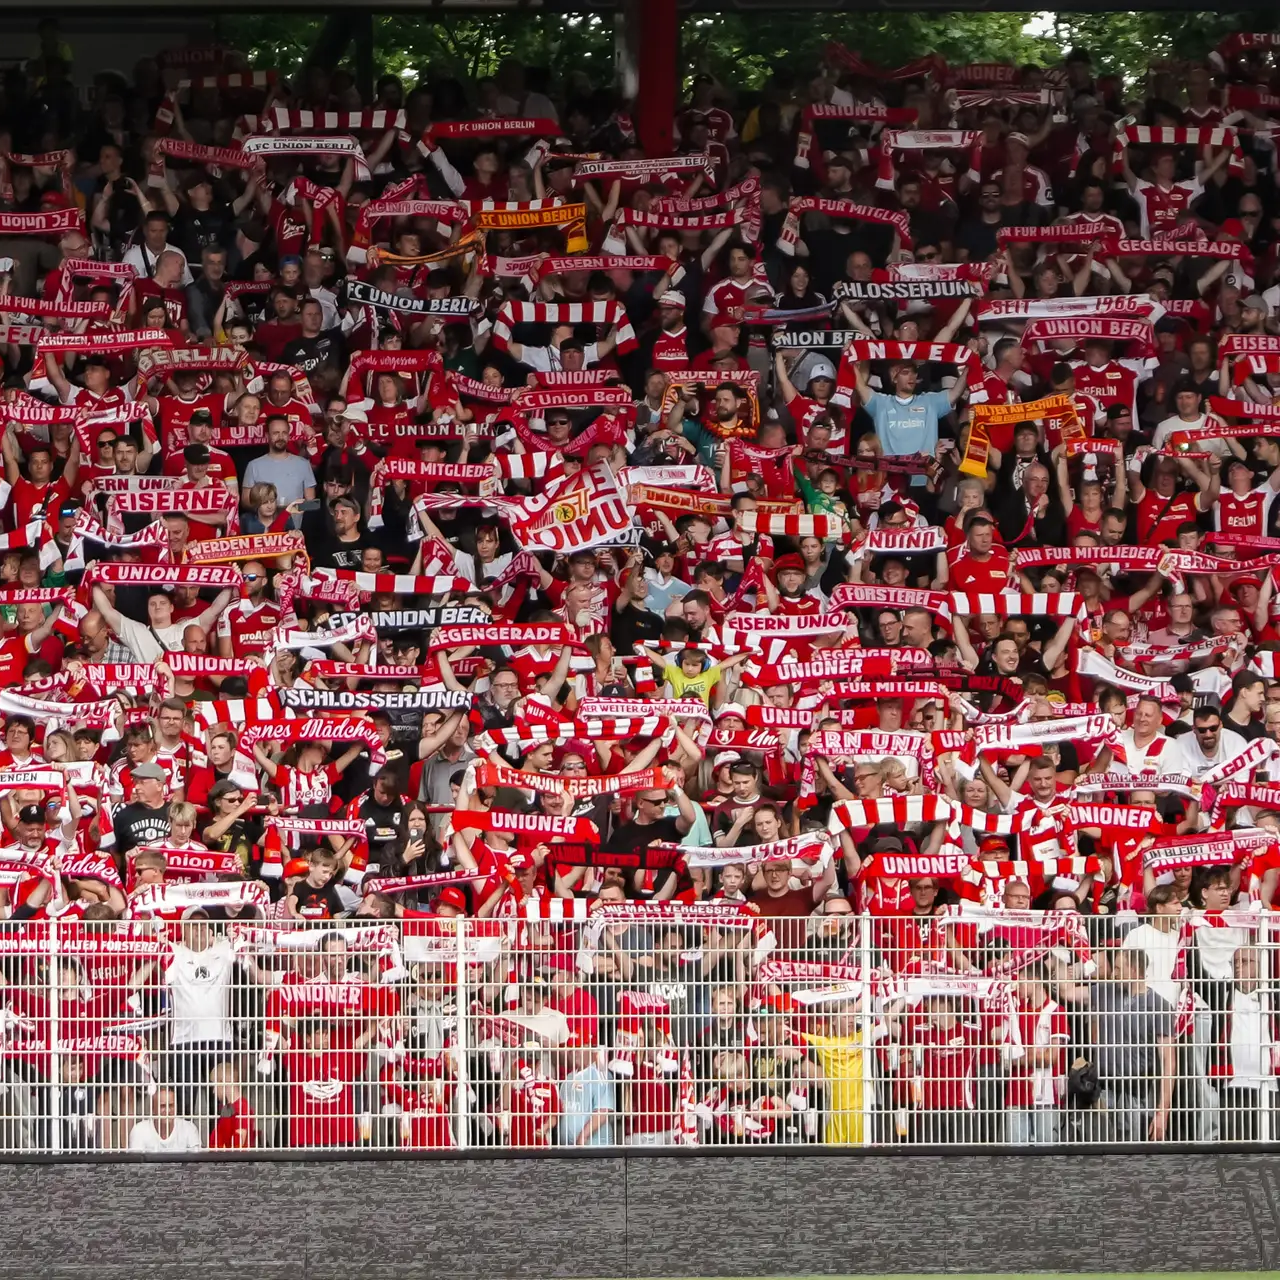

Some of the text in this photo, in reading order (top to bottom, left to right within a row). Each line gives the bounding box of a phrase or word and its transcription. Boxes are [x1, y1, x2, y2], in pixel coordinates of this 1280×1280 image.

[459, 123, 471, 132] FC
[473, 122, 500, 131] UNION
[503, 120, 535, 130] BERLIN
[273, 142, 311, 152] UNION
[500, 210, 538, 226] UNION
[541, 208, 586, 225] BERLIN
[1118, 240, 1240, 256] GEGENGERADE
[552, 256, 655, 270] EISERN UNION
[368, 289, 425, 310] UNION
[993, 300, 1031, 315] SEIT
[1045, 320, 1106, 336] UNION
[390, 460, 414, 473] FÜR
[190, 537, 256, 555] WERDEN
[1075, 547, 1160, 560] MITGLIEDER!
[117, 567, 184, 582] UNION
[334, 663, 418, 675] FC Union
[776, 658, 863, 678] UNIONER
[492, 813, 575, 833] UNIONER
[752, 841, 798, 860] 1966
[1165, 843, 1233, 856] BLEIBT ROT
